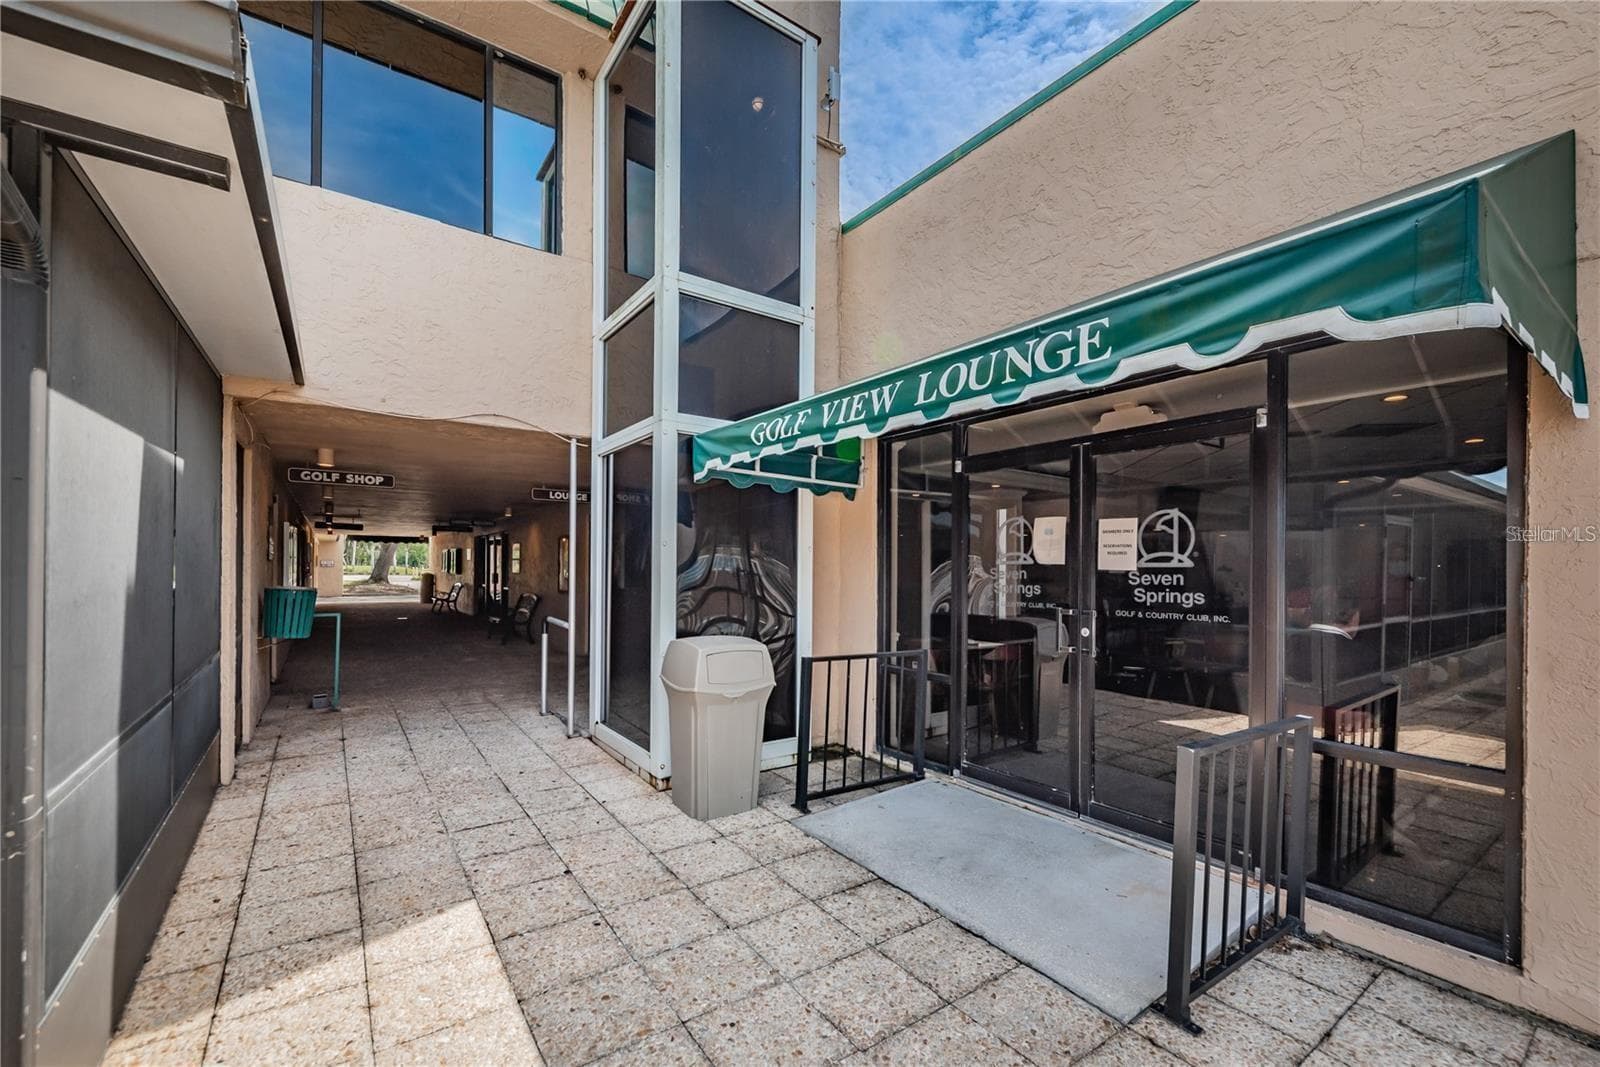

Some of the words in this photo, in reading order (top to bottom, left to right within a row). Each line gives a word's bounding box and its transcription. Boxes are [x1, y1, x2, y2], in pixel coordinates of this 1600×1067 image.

[750, 409, 811, 446] GOLF
[822, 380, 904, 428] VIEW
[914, 317, 1112, 406] LOUNGE
[300, 470, 340, 482] GOLF
[345, 474, 384, 485] SHOP
[549, 491, 588, 501] LOUGE
[1128, 571, 1184, 586] Seven
[1134, 588, 1206, 608] Springs
[1145, 612, 1184, 620] COUNTRY
[1186, 614, 1211, 623] CLUB,
